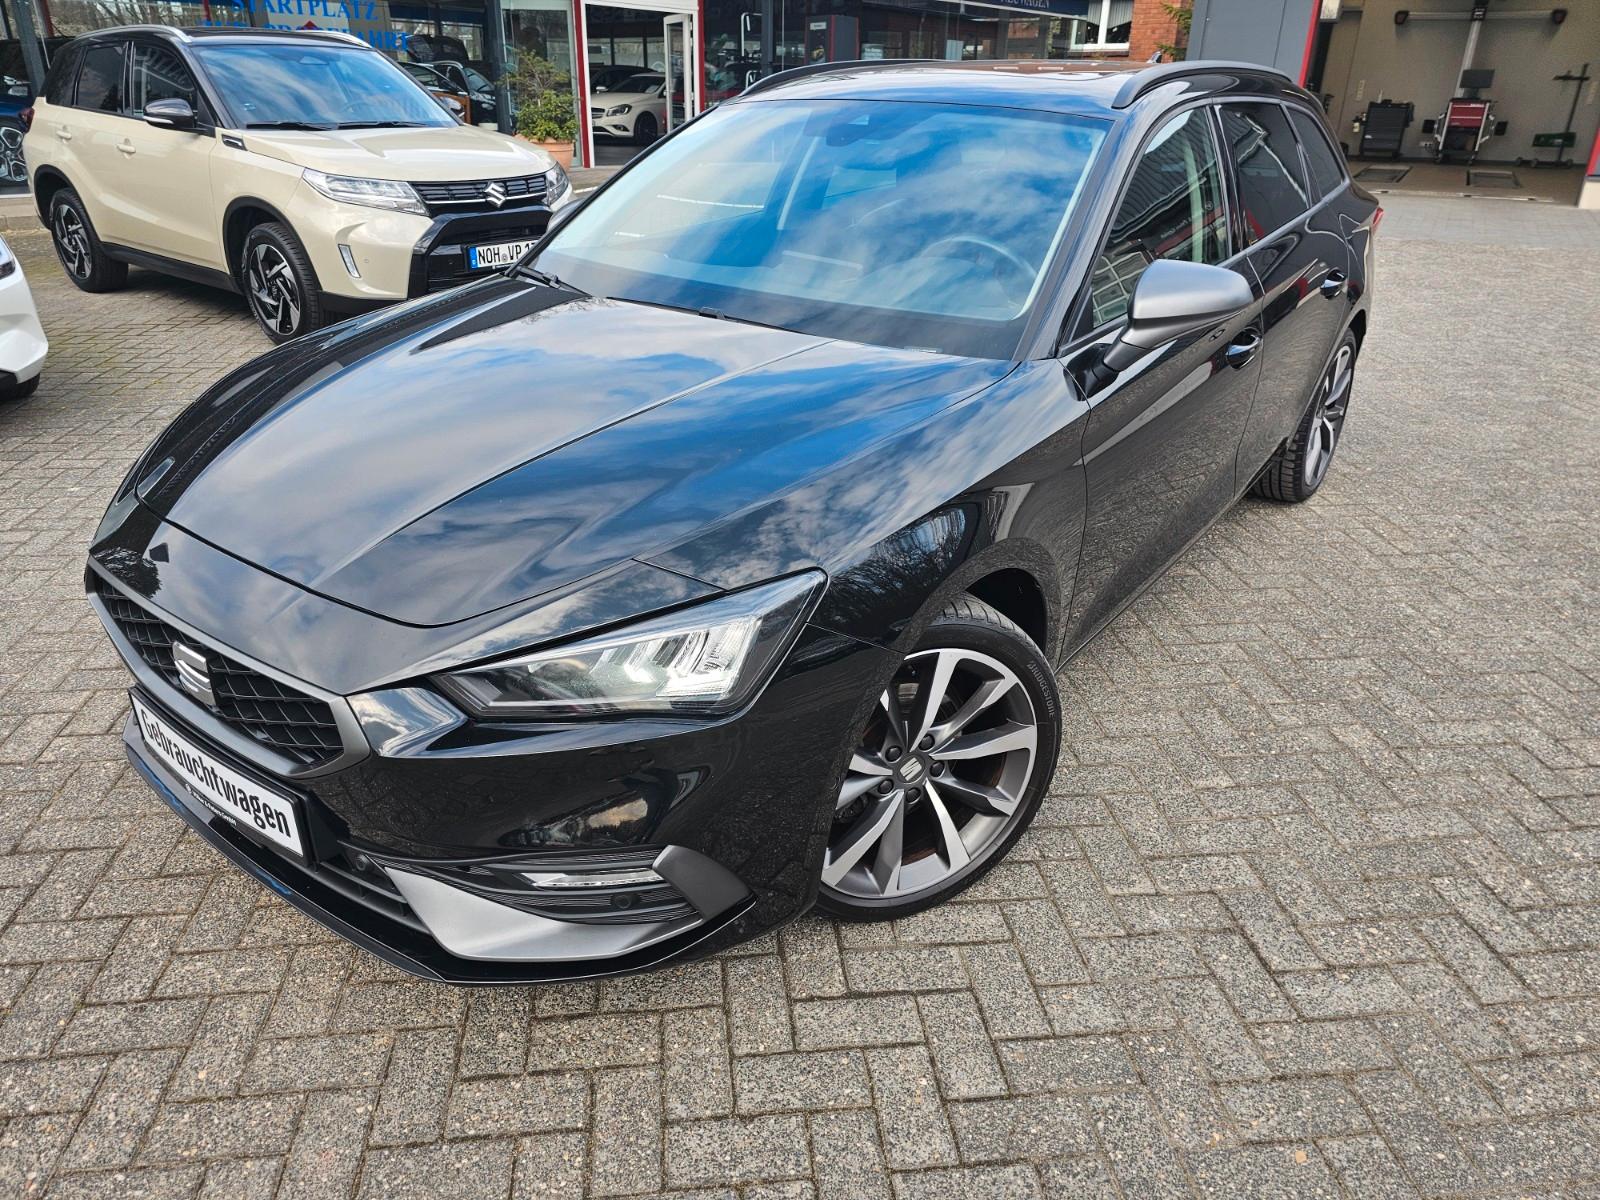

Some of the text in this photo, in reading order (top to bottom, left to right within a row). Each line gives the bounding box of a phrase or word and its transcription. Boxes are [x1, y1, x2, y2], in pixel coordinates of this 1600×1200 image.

[478, 247, 501, 265] NOH
[508, 244, 521, 261] VP
[1026, 660, 1055, 719] BRIDGESTONE
[141, 708, 292, 838] Gebrauchtwagen
